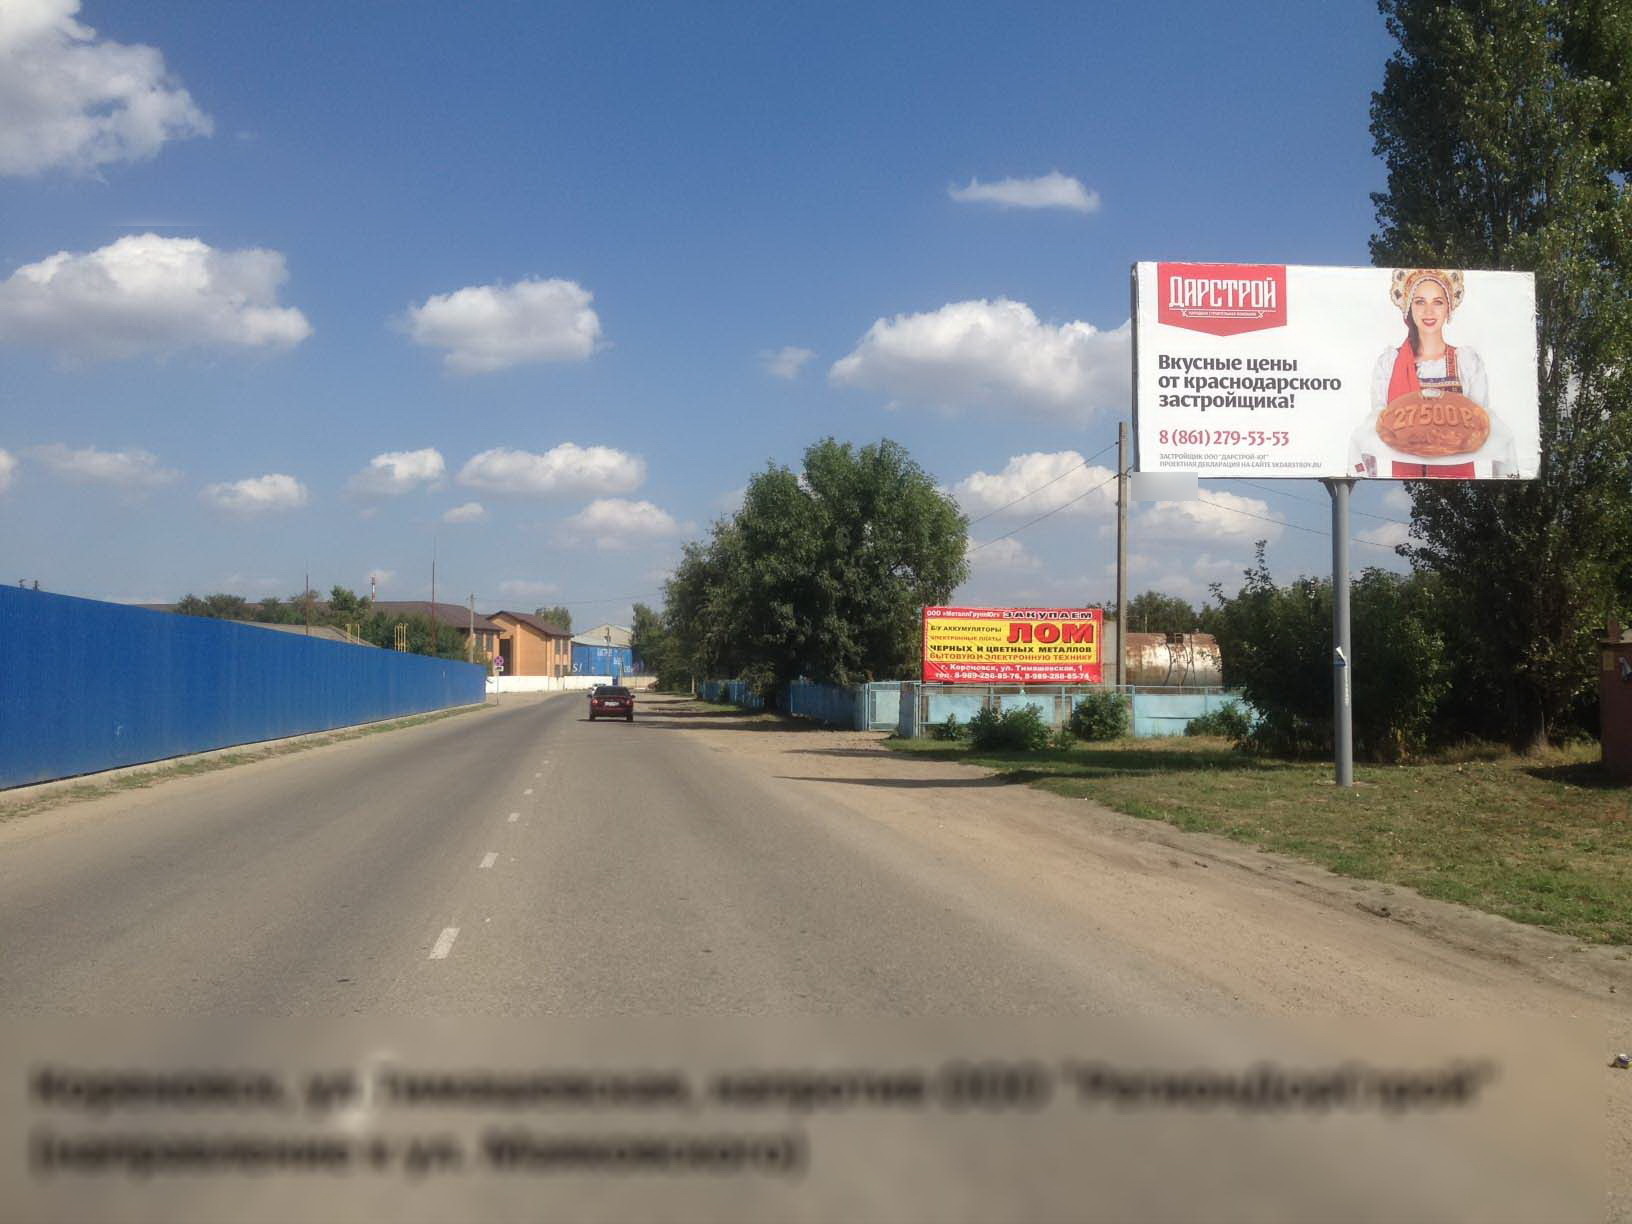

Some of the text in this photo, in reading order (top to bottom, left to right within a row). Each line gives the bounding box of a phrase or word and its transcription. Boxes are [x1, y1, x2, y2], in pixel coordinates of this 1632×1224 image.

[1168, 276, 1277, 308] ДАРСТРОЙ
[1158, 354, 1298, 374] Вкусные цены
[1158, 375, 1342, 394] от краснодарского
[1159, 391, 1295, 412] застройщика!
[1159, 429, 1290, 446] 8 (861) 279-53-53
[1159, 452, 1203, 460] ЗАСТРОЙЩИК
[1003, 611, 1093, 620] ЗАКУПАЕМ
[1007, 622, 1094, 644] ЛОМ
[929, 652, 975, 660] БЫТОВУЮ
[984, 653, 1051, 661] ЭЛЕКТРОННУЮ
